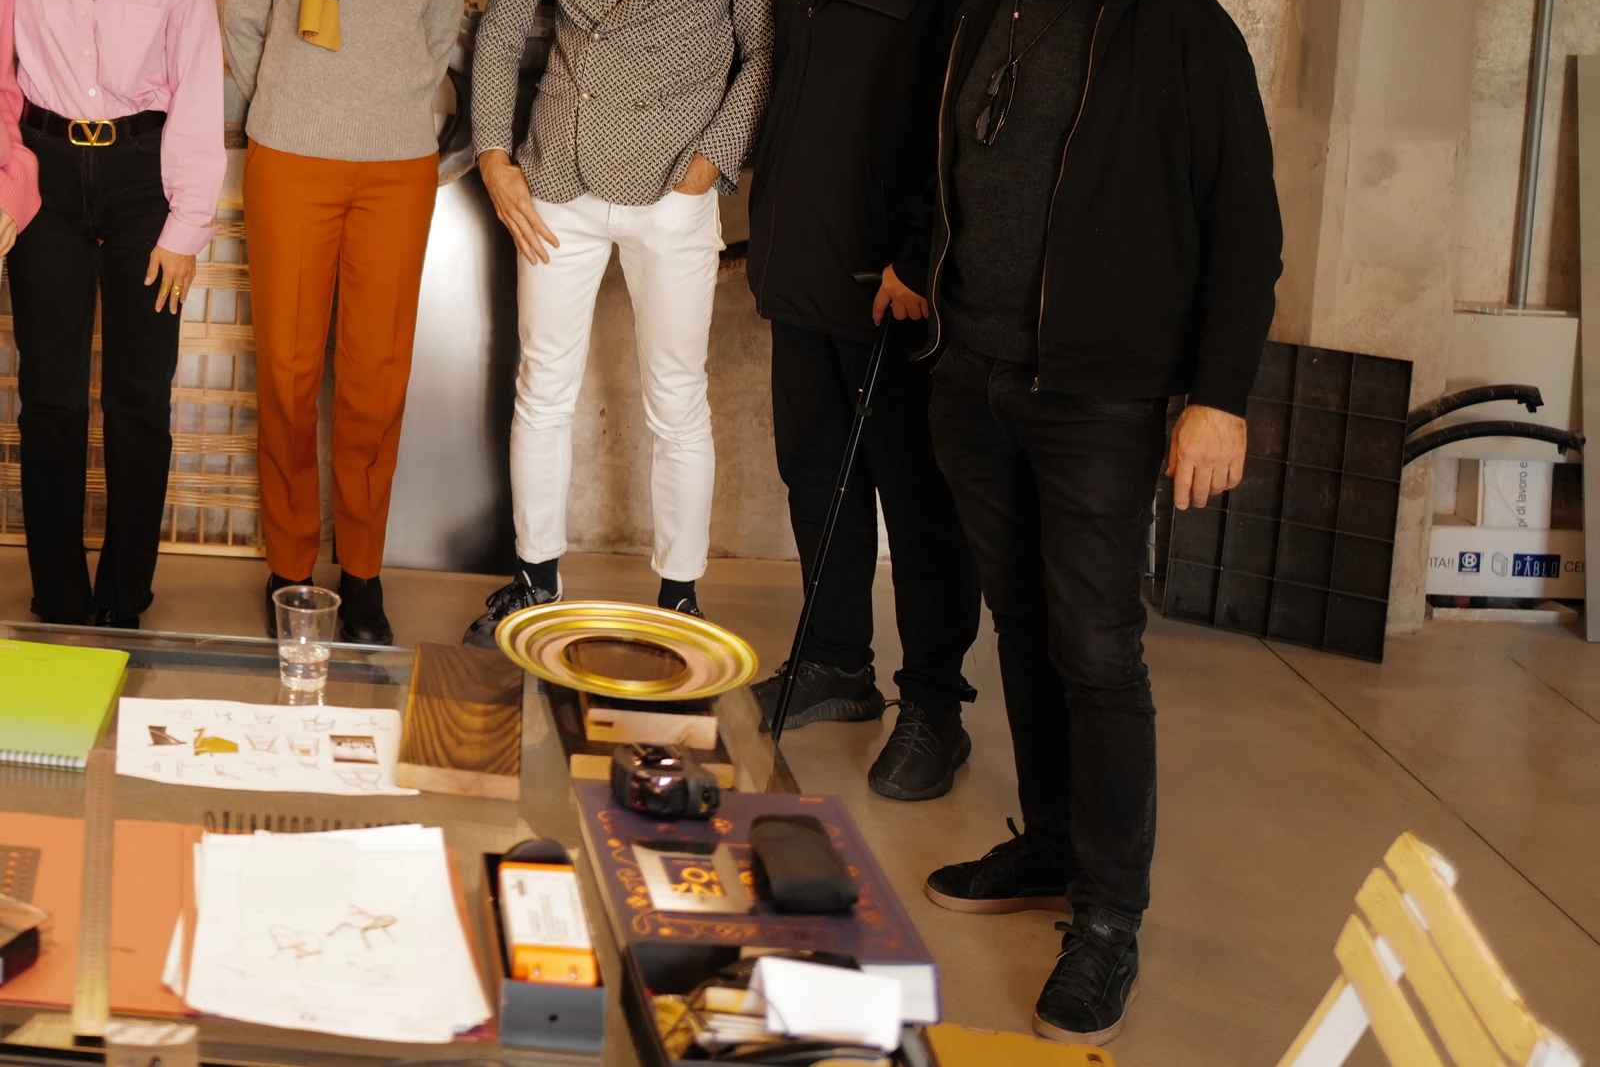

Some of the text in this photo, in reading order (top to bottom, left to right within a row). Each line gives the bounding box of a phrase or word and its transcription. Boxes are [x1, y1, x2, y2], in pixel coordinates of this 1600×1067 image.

[1520, 461, 1528, 469] e
[1516, 471, 1528, 503] lavoro
[1516, 506, 1526, 515] di
[1428, 557, 1454, 569] ITA!!
[1514, 559, 1558, 578] PABLO
